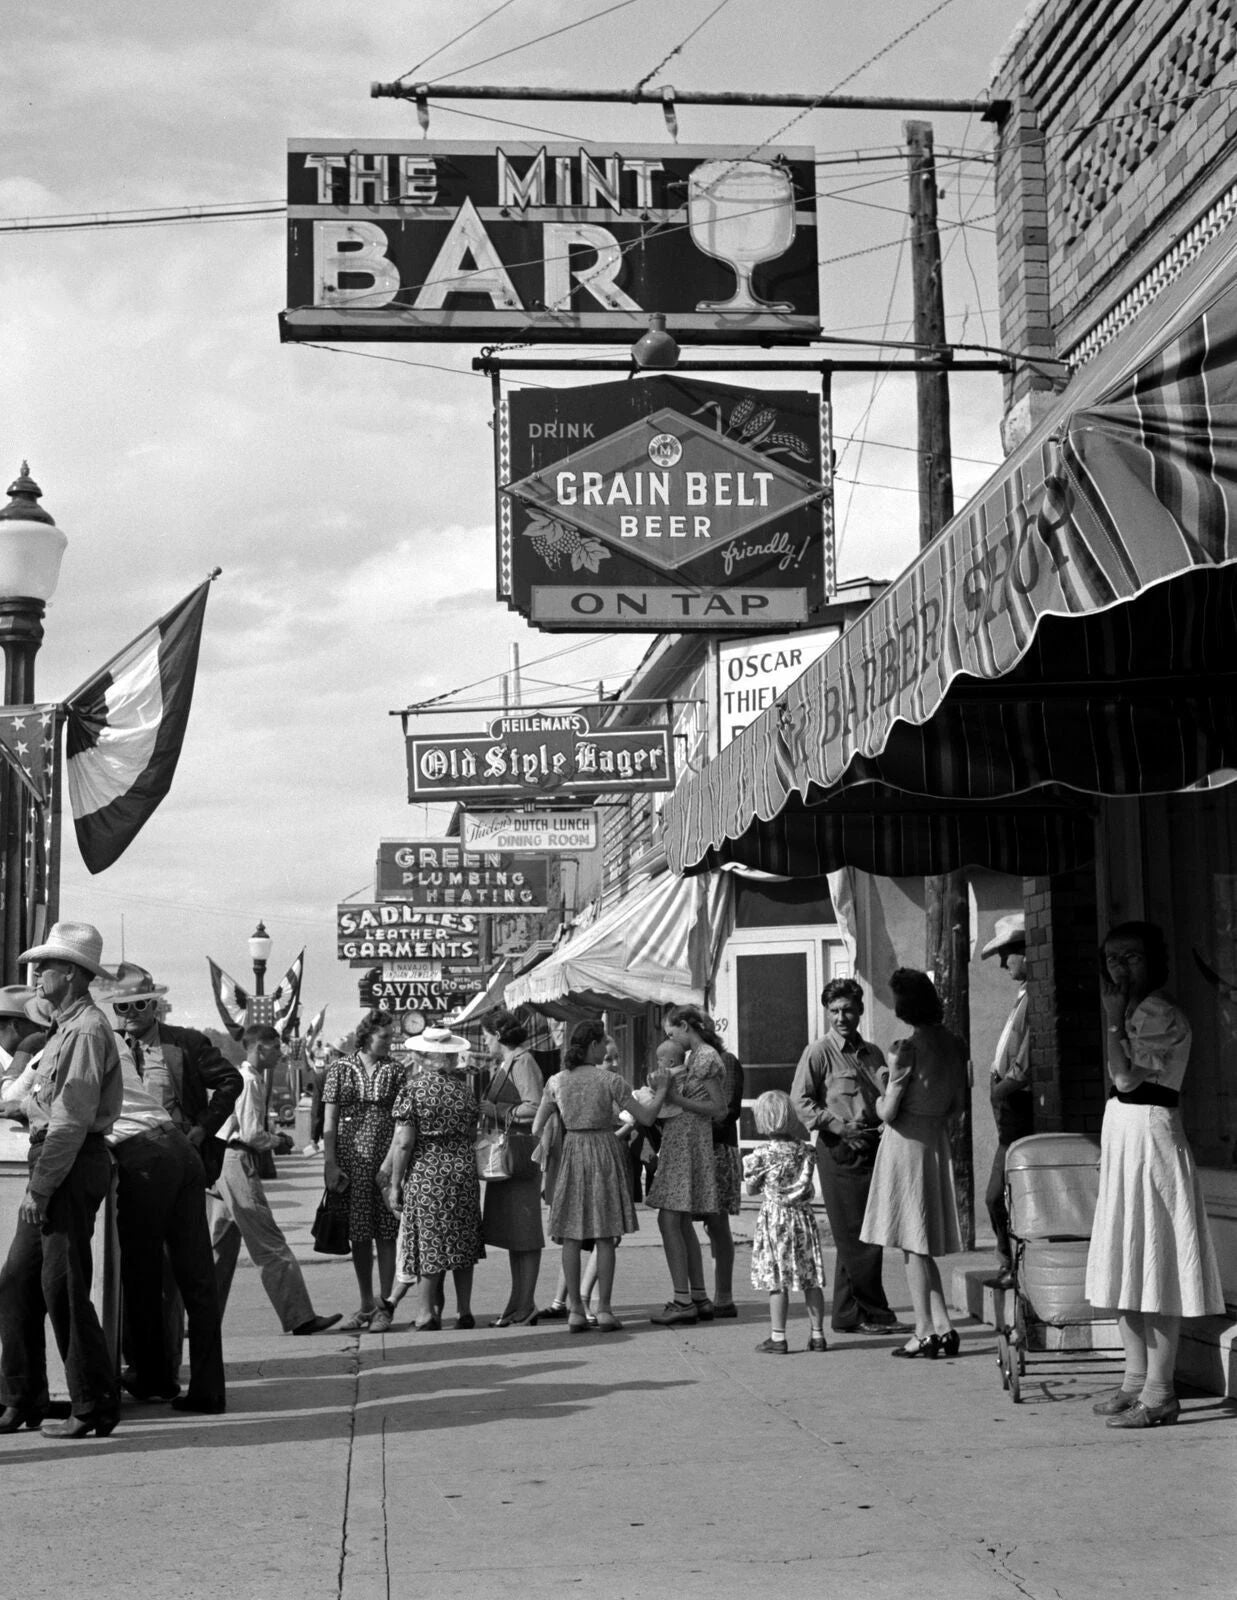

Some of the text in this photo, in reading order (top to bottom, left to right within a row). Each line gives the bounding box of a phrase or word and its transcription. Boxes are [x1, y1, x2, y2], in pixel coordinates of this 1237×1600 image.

[304, 146, 665, 215] THE MINT
[312, 196, 643, 311] BAR
[528, 423, 596, 439] DRINK
[555, 471, 775, 507] GRAIN BELT
[619, 515, 712, 538] BEER
[721, 532, 811, 576] friendly!
[570, 592, 770, 616] ON TAP
[727, 648, 803, 682] OSCAR
[501, 716, 581, 733] HEILEMAN'S
[420, 741, 664, 783] Old Style Lager
[514, 818, 549, 832] DUTCH
[553, 818, 590, 831] LUNCH
[497, 834, 590, 847] DINING ROOM
[394, 847, 501, 868] GREEN
[402, 872, 525, 885] PLUMBING
[426, 888, 533, 903] HEATING
[340, 905, 478, 934] SADDLES
[365, 928, 450, 940] LEATHER
[343, 941, 474, 958] GARMENTS
[378, 997, 449, 1011] & LOAN
